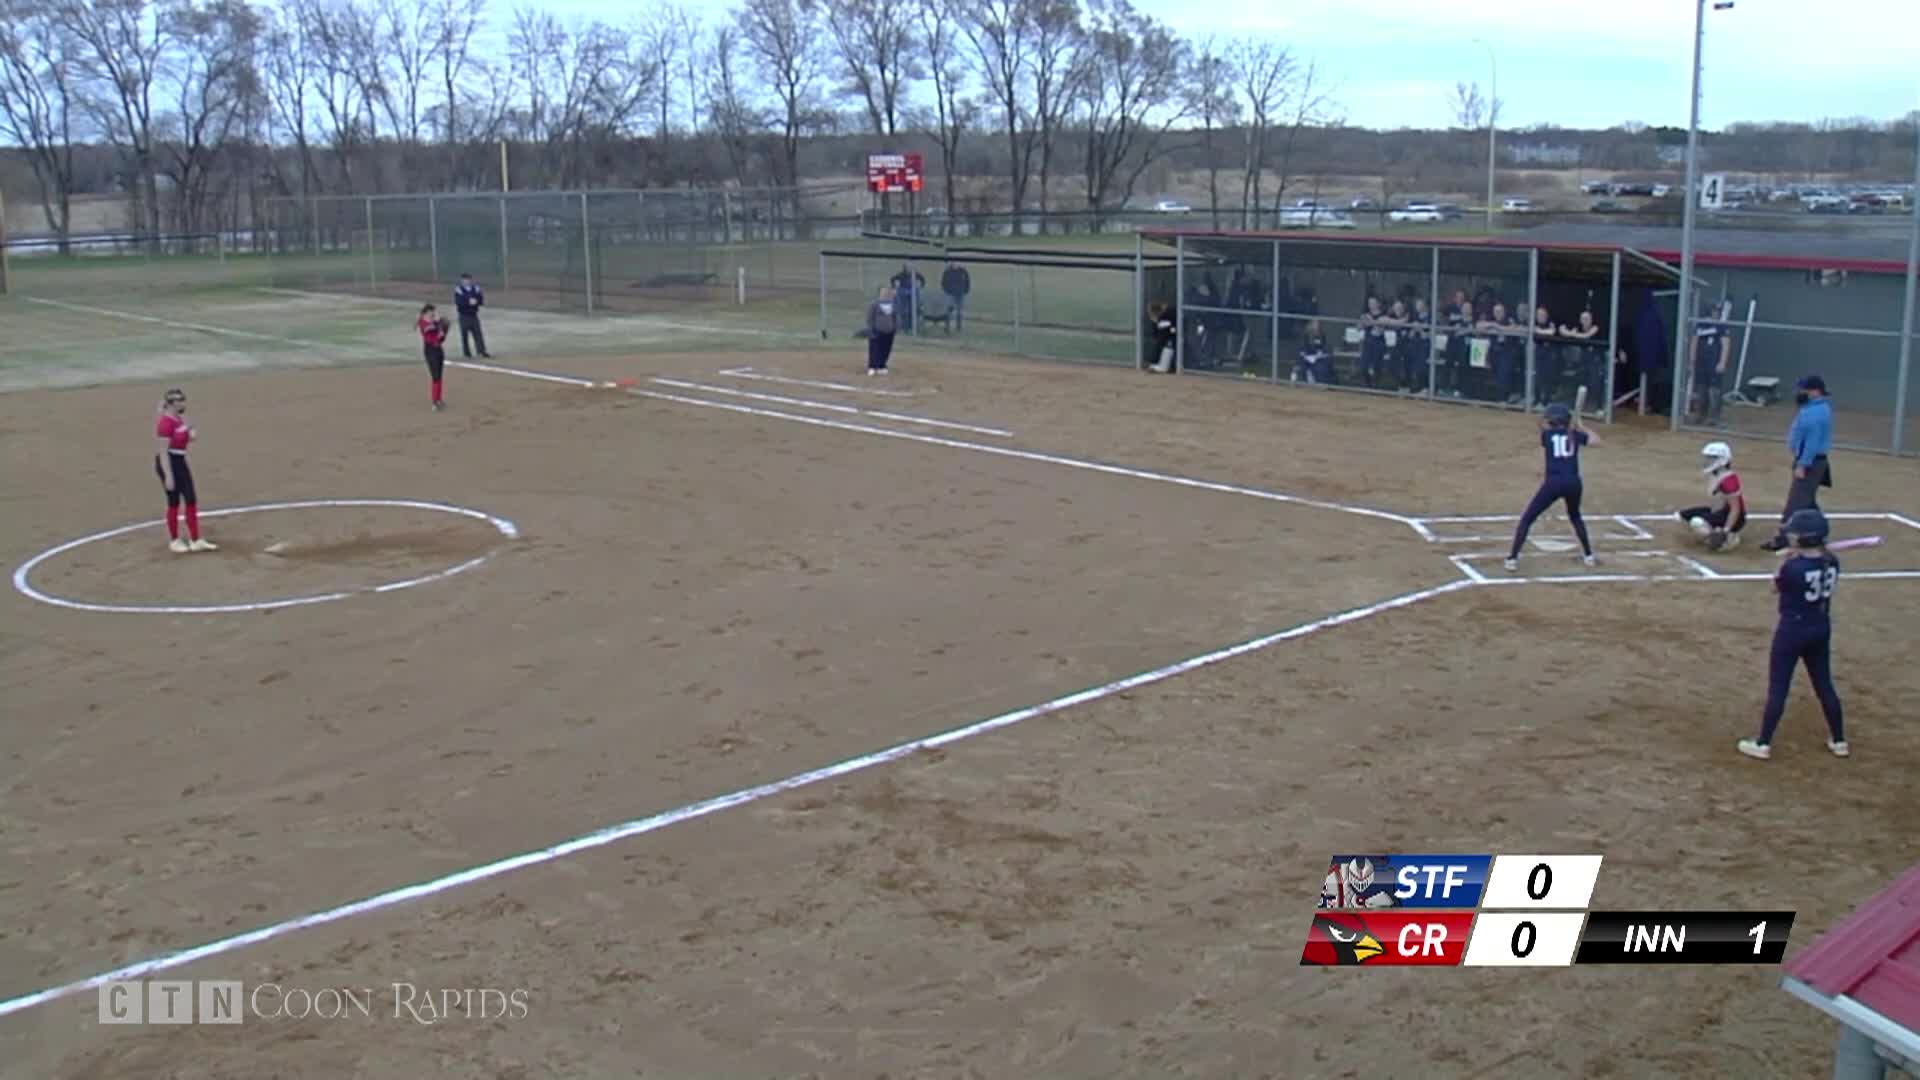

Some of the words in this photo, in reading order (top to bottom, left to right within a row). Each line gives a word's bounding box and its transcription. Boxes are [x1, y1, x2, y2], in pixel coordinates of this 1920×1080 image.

[1705, 178, 1718, 204] 4
[1551, 433, 1576, 458] 10
[1804, 566, 1838, 603] 33
